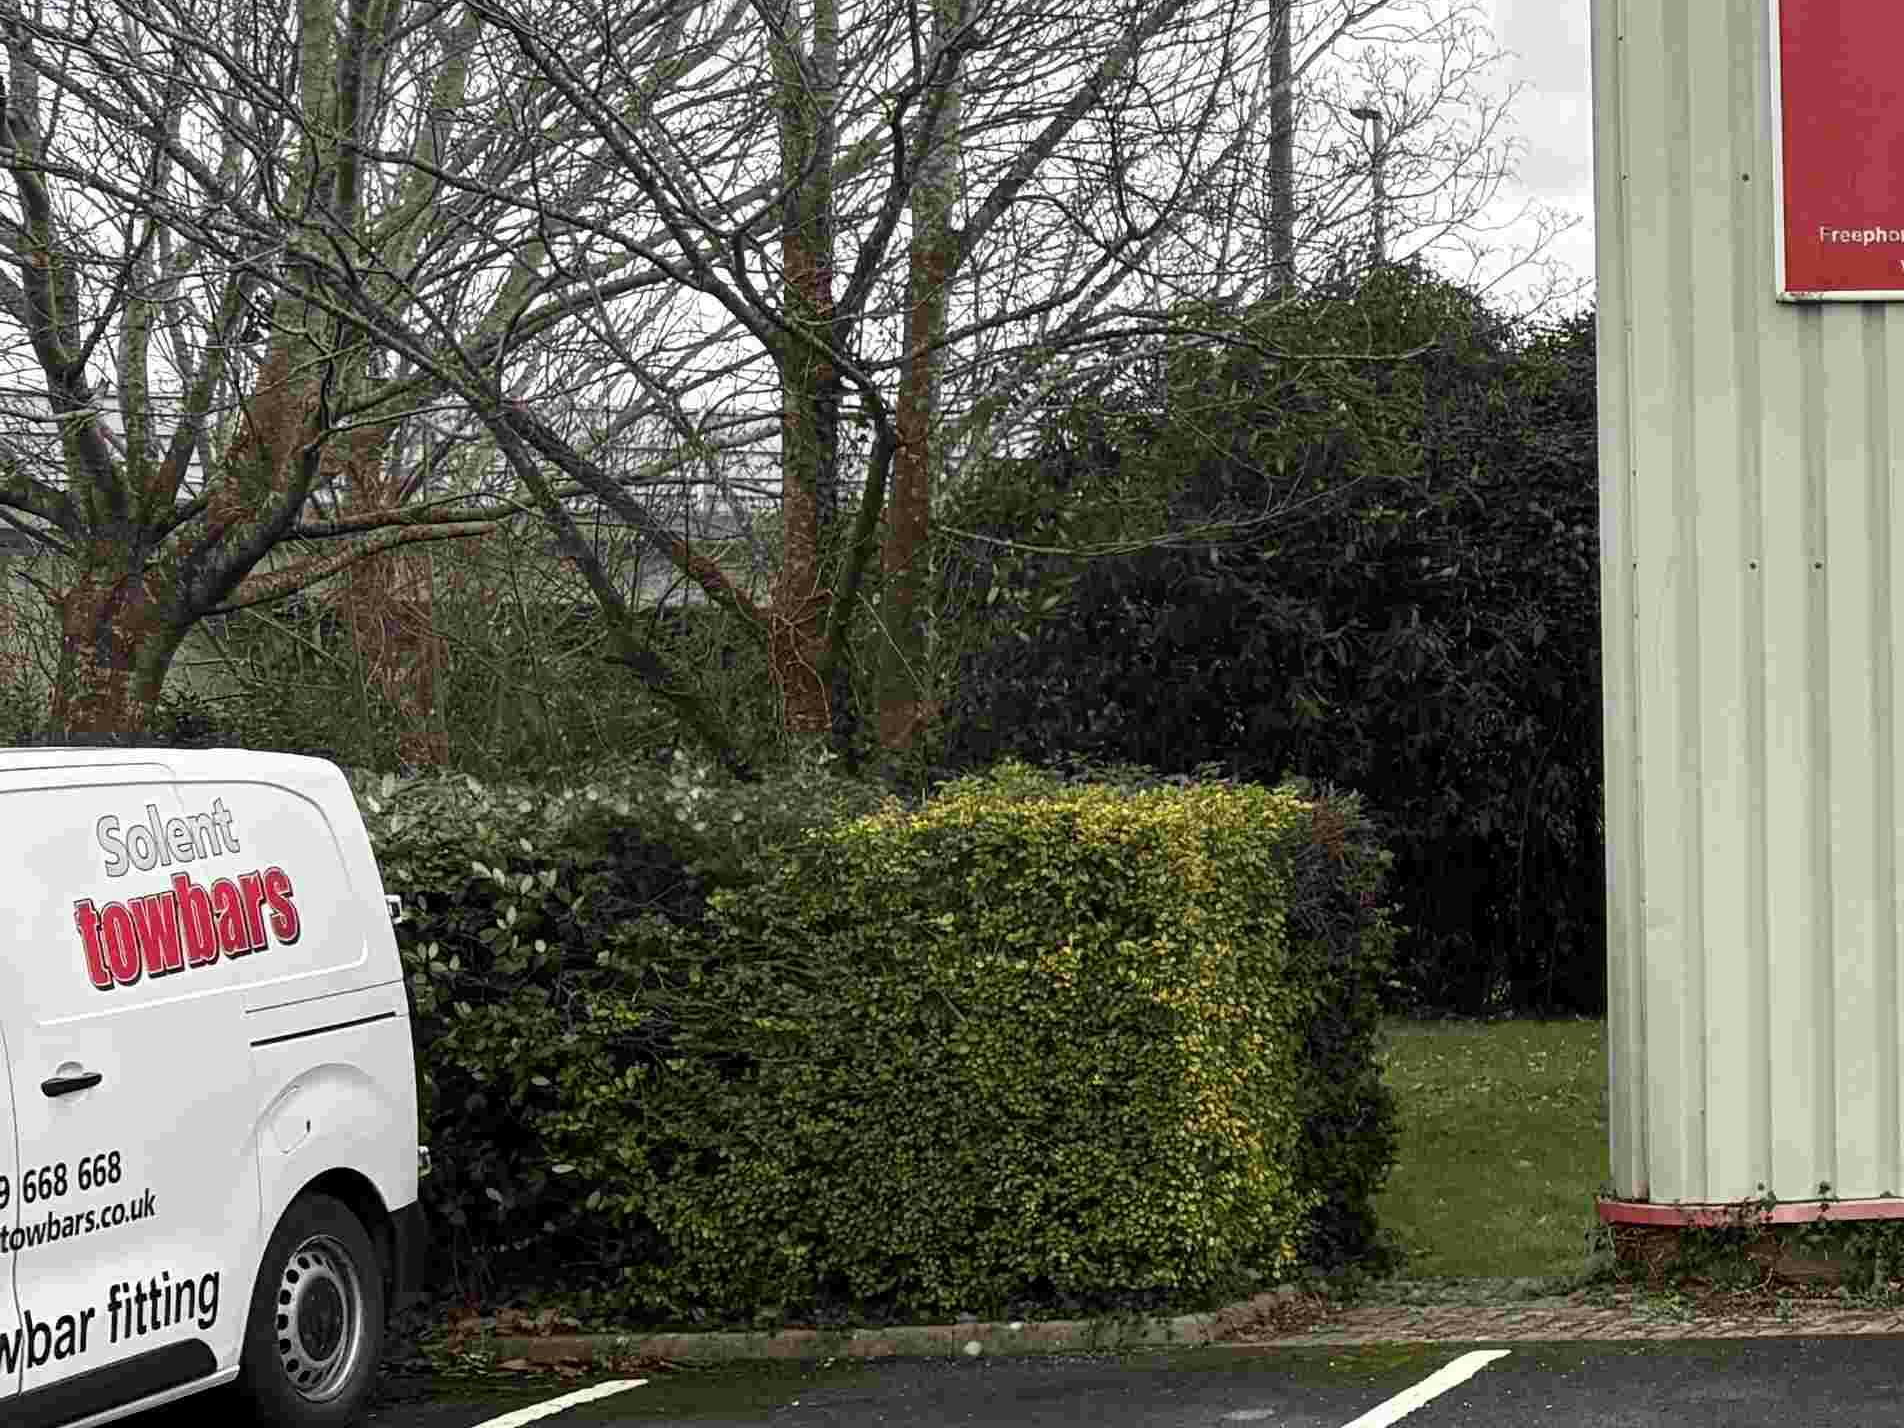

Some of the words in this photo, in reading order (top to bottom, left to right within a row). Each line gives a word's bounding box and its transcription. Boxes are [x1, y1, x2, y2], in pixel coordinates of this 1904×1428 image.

[96, 797, 241, 878] Solent
[73, 866, 300, 991] towbars
[23, 1162, 68, 1204] 668
[78, 1149, 122, 1192] 668
[108, 1270, 220, 1344] fitting
